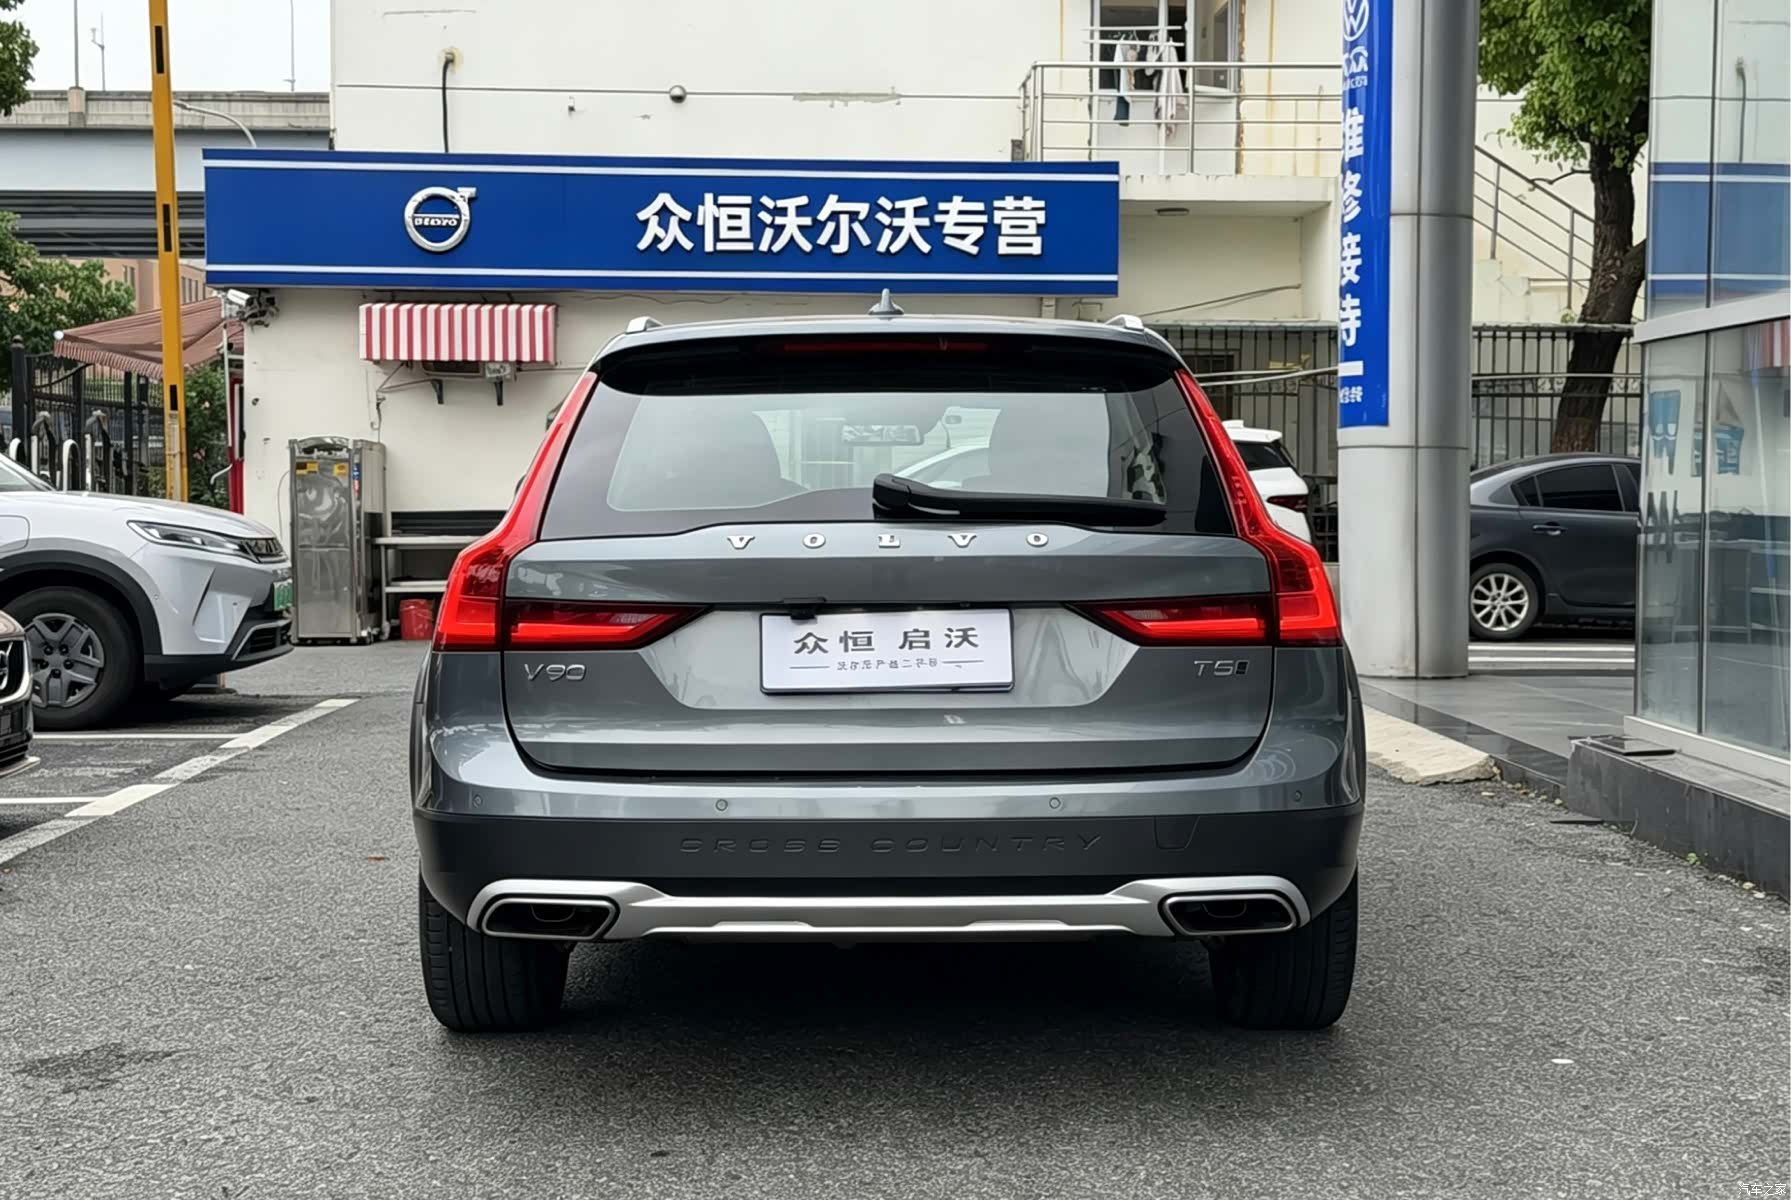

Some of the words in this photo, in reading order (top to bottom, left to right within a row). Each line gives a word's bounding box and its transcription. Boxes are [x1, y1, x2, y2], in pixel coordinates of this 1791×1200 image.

[636, 192, 1047, 255] 众恒沃尔沃专营
[727, 533, 1049, 549] VOLVO
[524, 664, 586, 681] V90
[1194, 660, 1234, 676] T5
[679, 838, 842, 853] CROSS
[869, 836, 1102, 853] COUNTRY
